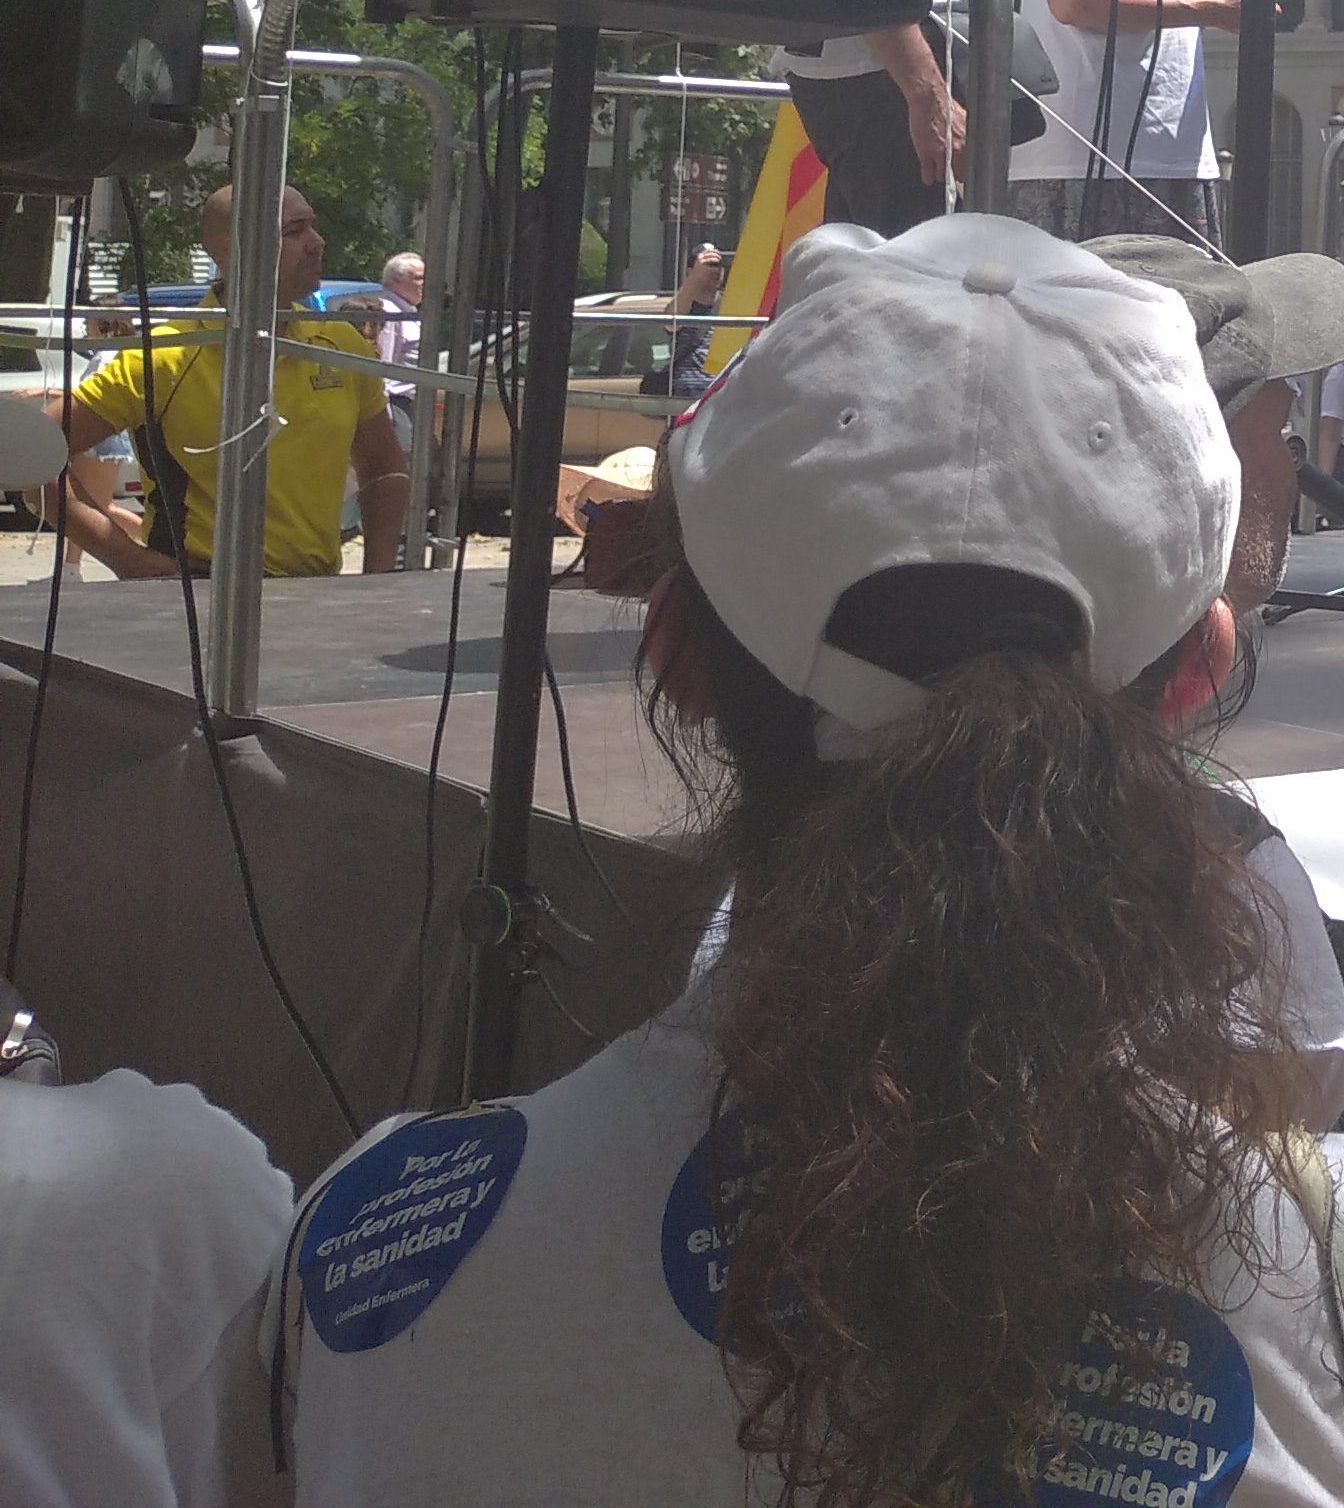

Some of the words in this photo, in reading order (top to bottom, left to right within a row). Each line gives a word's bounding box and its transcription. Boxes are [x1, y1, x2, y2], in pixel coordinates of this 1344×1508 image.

[348, 1152, 495, 1226] profesión
[399, 1147, 455, 1181] Por
[452, 1138, 483, 1162] la
[315, 1184, 473, 1258] enfermera
[469, 1176, 498, 1209] y
[324, 1261, 347, 1293] la
[349, 1210, 468, 1279] sanidad
[334, 1296, 372, 1326] Unidad
[371, 1276, 432, 1309] Enfermera
[1058, 1359, 1218, 1425] rofesión
[1200, 1446, 1230, 1483] y
